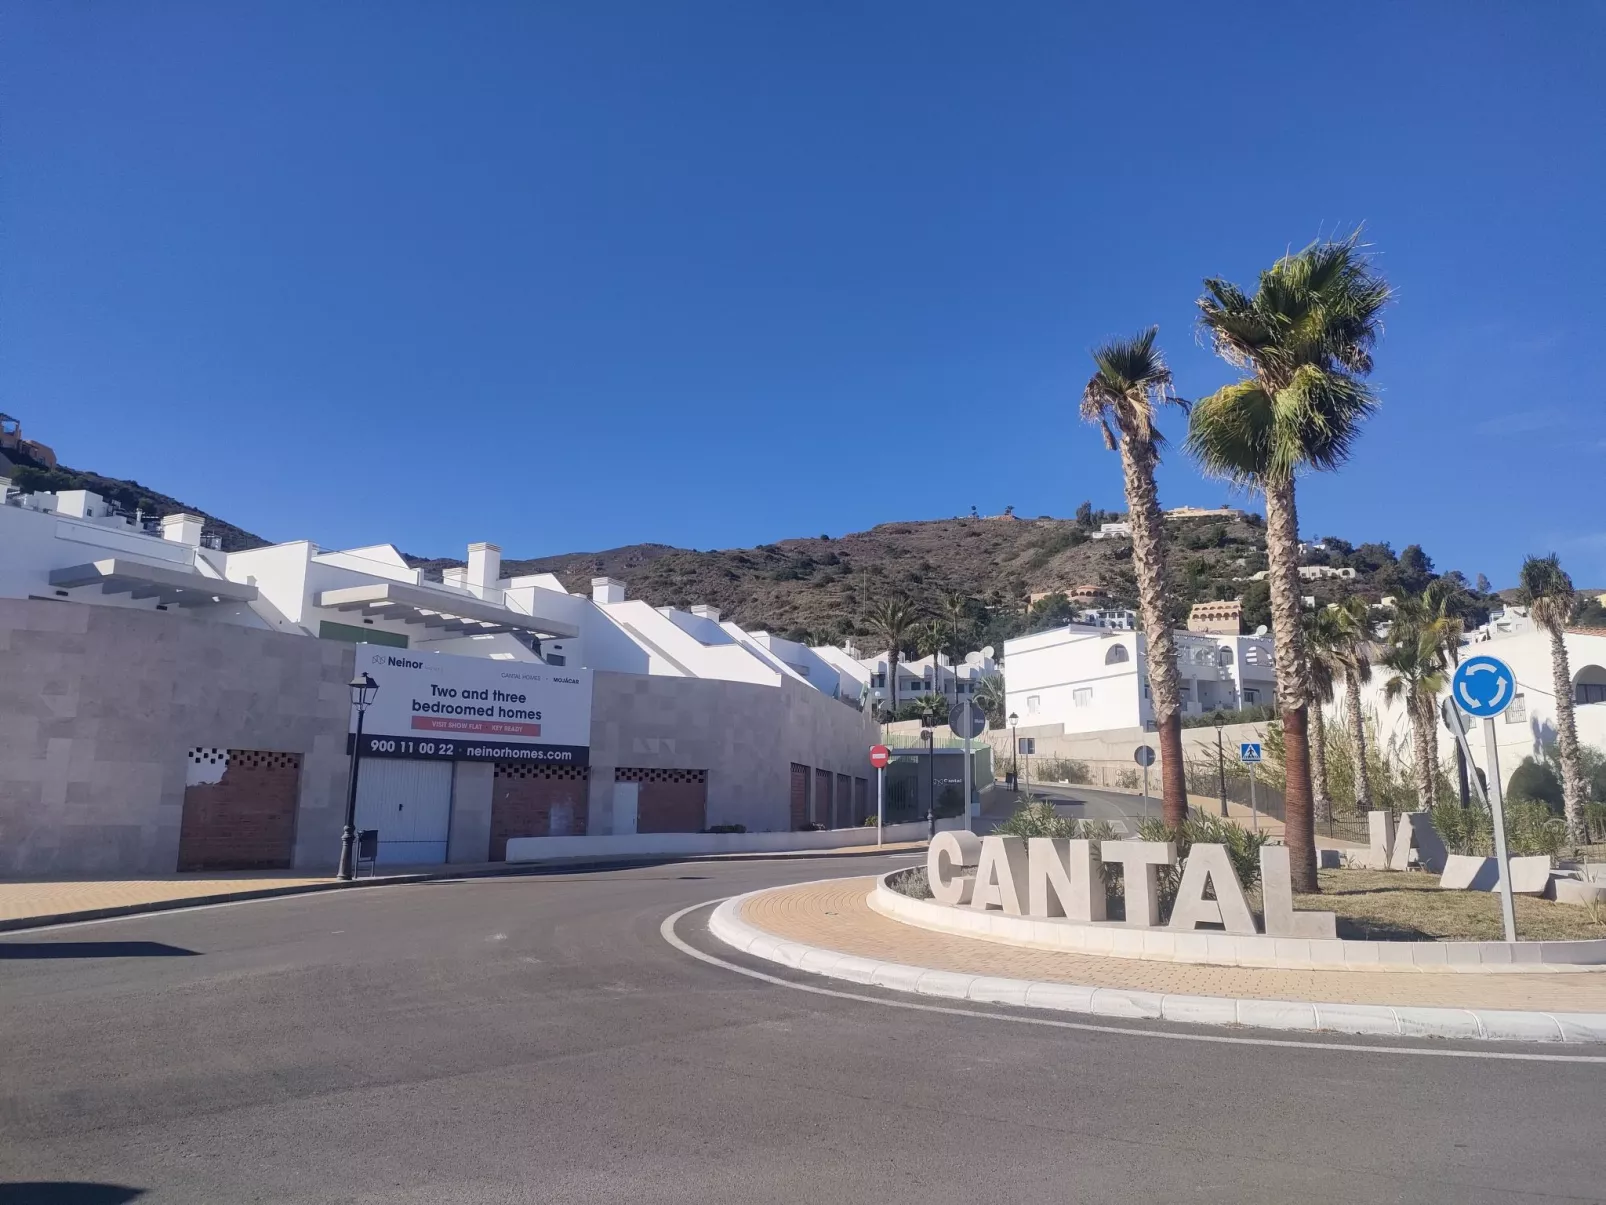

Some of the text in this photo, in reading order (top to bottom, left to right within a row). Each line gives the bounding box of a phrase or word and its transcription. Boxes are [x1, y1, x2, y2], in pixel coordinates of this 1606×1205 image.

[388, 656, 423, 669] Neinor
[430, 684, 526, 704] Two and three
[412, 699, 542, 720] bedroomed homes
[432, 720, 447, 728] VISIT
[448, 721, 468, 729] SHOW
[370, 739, 454, 755] 900 11 00 22
[467, 746, 572, 760] neinorhomes.com
[927, 830, 1337, 938] CANTAL
